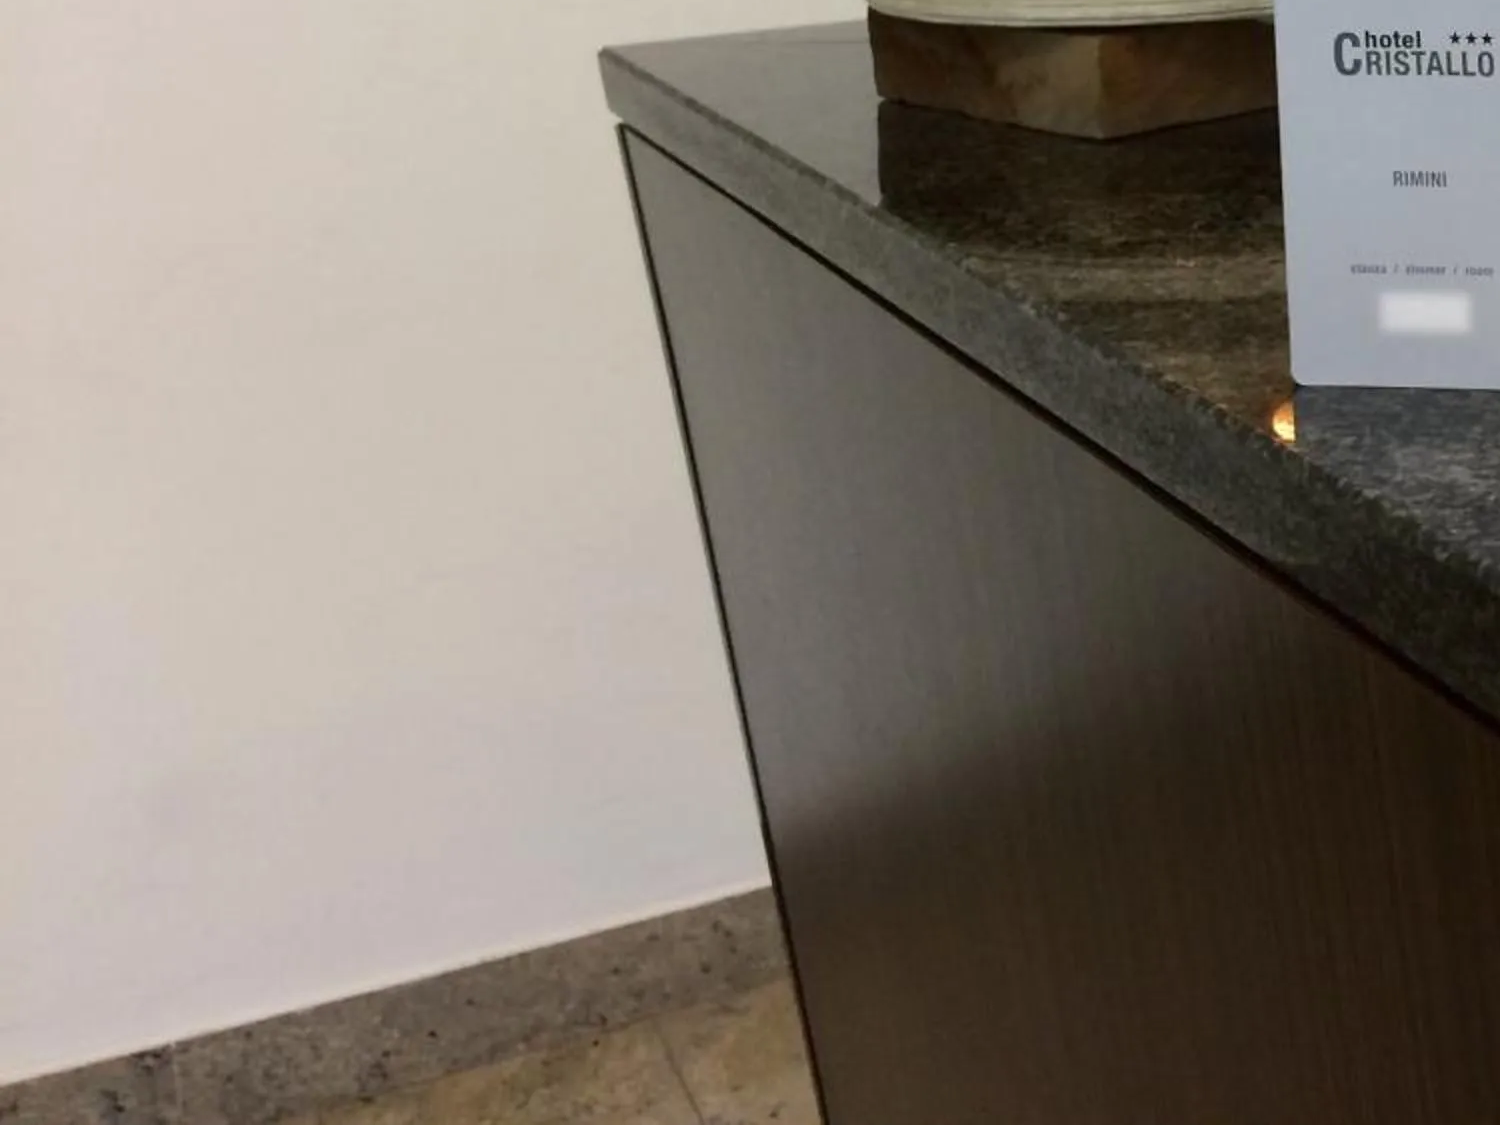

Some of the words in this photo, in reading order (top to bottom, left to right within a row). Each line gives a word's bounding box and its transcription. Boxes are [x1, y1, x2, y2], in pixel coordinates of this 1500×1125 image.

[1365, 30, 1421, 49] hotel
[1333, 31, 1495, 78] CRISTALLO
[1393, 170, 1448, 188] RIMINI
